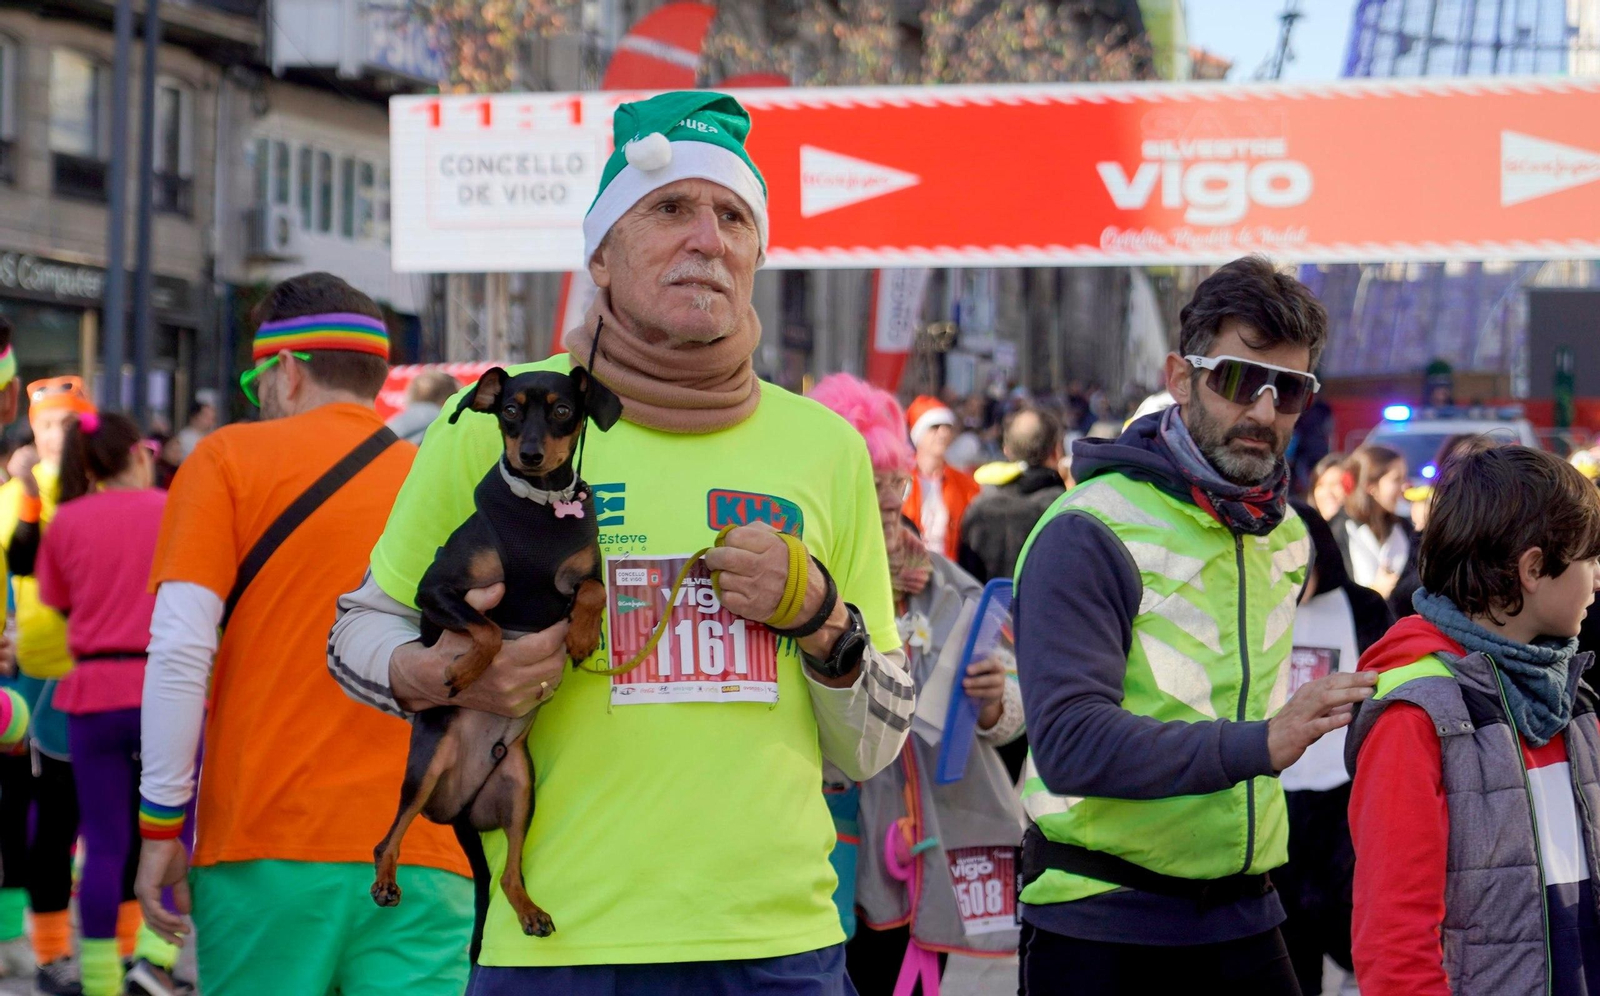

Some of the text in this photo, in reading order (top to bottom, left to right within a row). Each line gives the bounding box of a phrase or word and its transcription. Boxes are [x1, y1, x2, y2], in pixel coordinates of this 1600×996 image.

[676, 117, 719, 134] uga
[440, 152, 584, 177] CONCELLO
[457, 183, 567, 206] DE VIGO
[1095, 159, 1313, 226] vigo
[661, 587, 720, 614] vig
[653, 618, 747, 676] 1161
[952, 879, 1002, 917] 508
